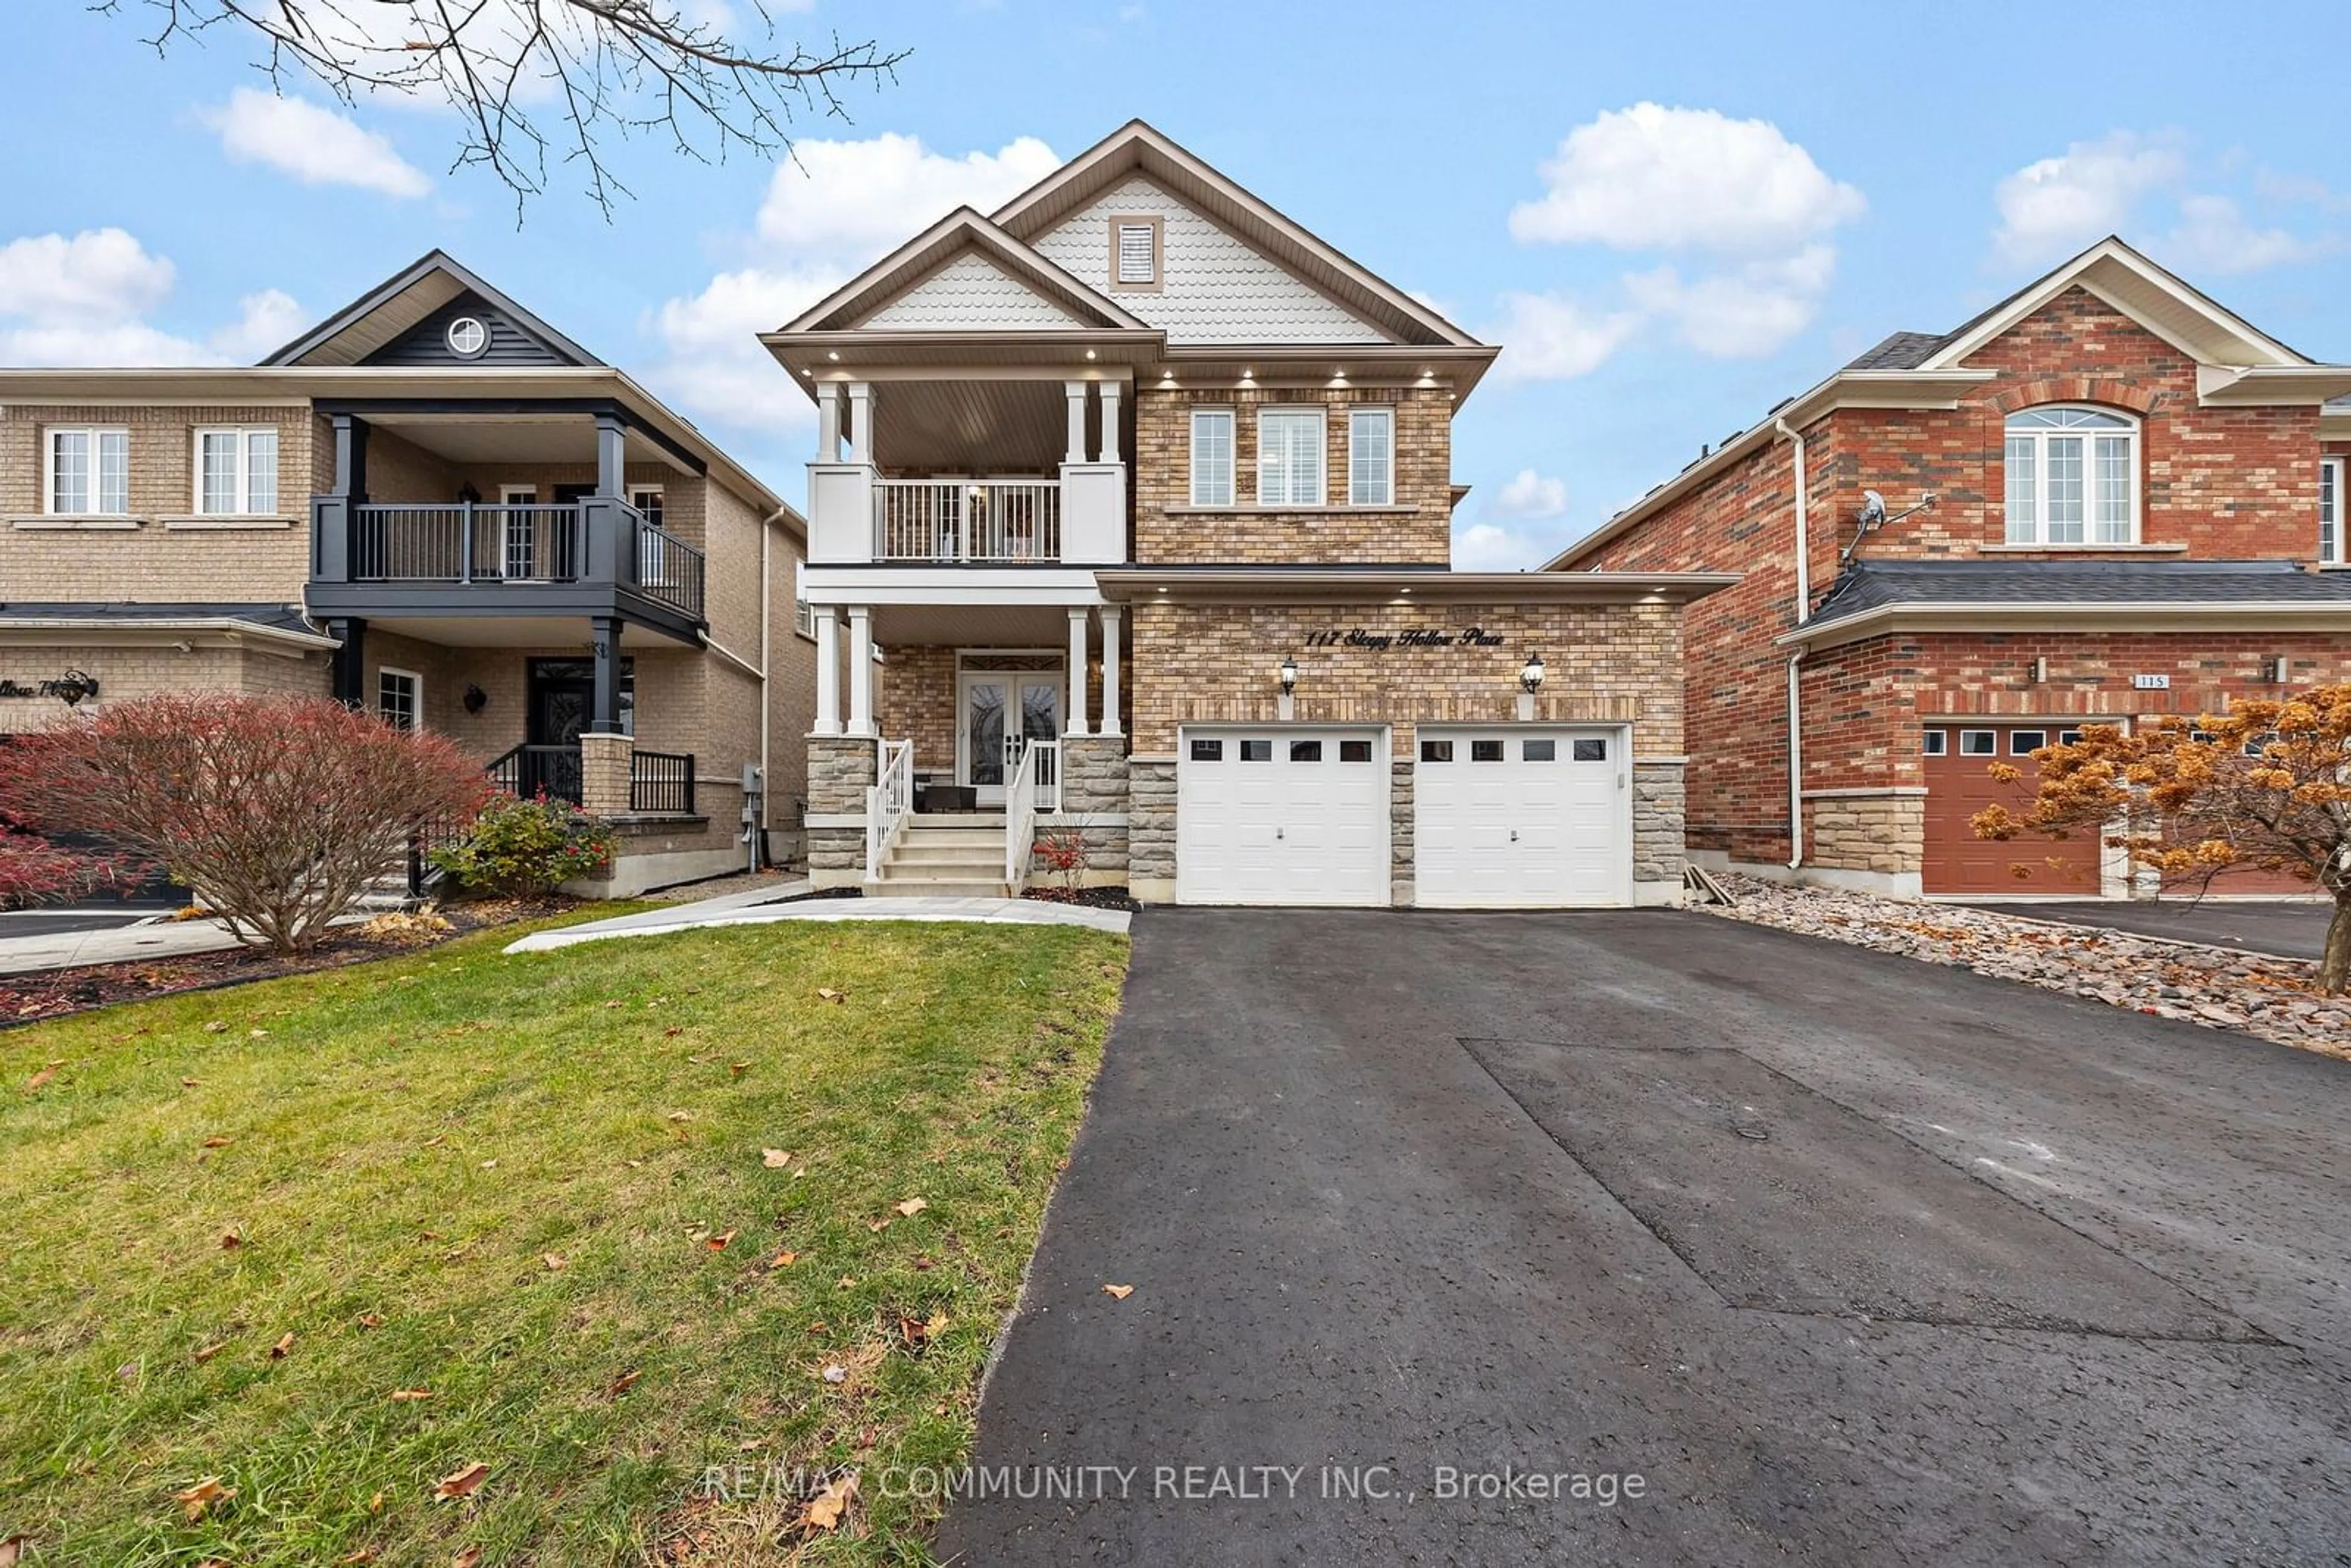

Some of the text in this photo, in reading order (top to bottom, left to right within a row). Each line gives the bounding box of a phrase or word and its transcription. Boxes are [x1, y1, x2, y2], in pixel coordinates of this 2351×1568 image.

[1307, 627, 1504, 651] 117 Sleepy Hollow Place
[2142, 676, 2164, 687] 115
